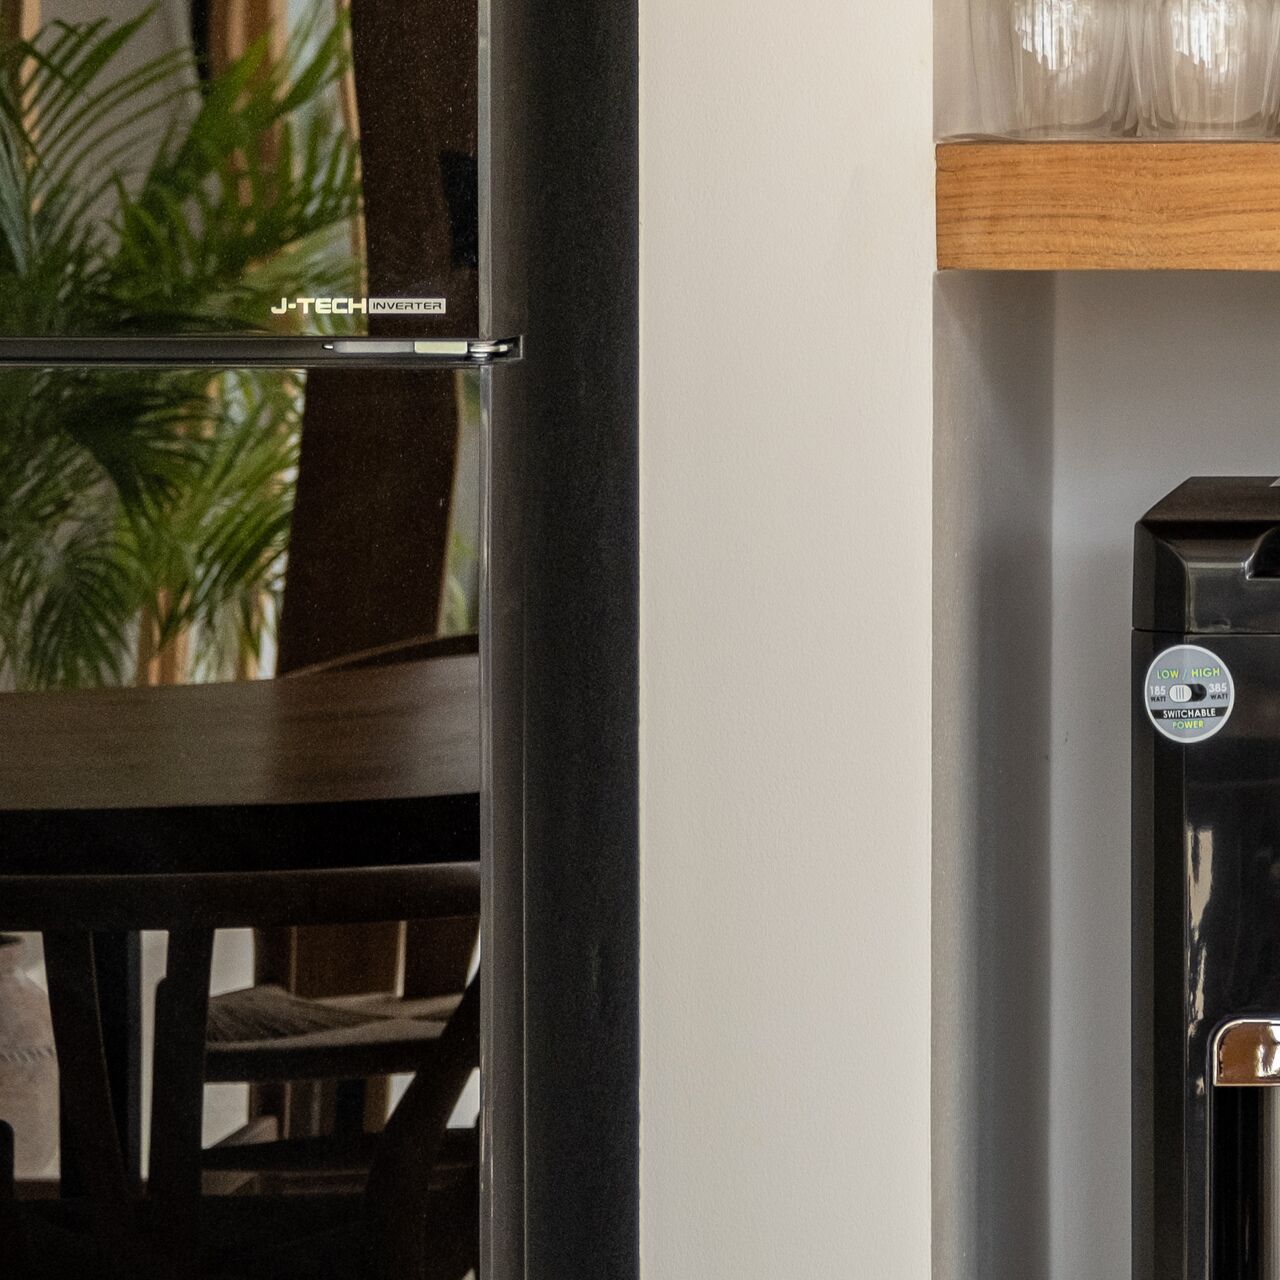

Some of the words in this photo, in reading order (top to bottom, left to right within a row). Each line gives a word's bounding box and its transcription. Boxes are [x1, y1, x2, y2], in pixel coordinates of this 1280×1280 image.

[270, 298, 366, 314] J-TECH
[372, 302, 442, 310] INVERTER
[1157, 668, 1179, 679] LOW
[1192, 667, 1220, 678] HIGH
[1150, 686, 1166, 695] 185
[1208, 682, 1227, 692] 385
[1163, 708, 1216, 718] SWITCHABLE
[1172, 721, 1204, 730] POWER
